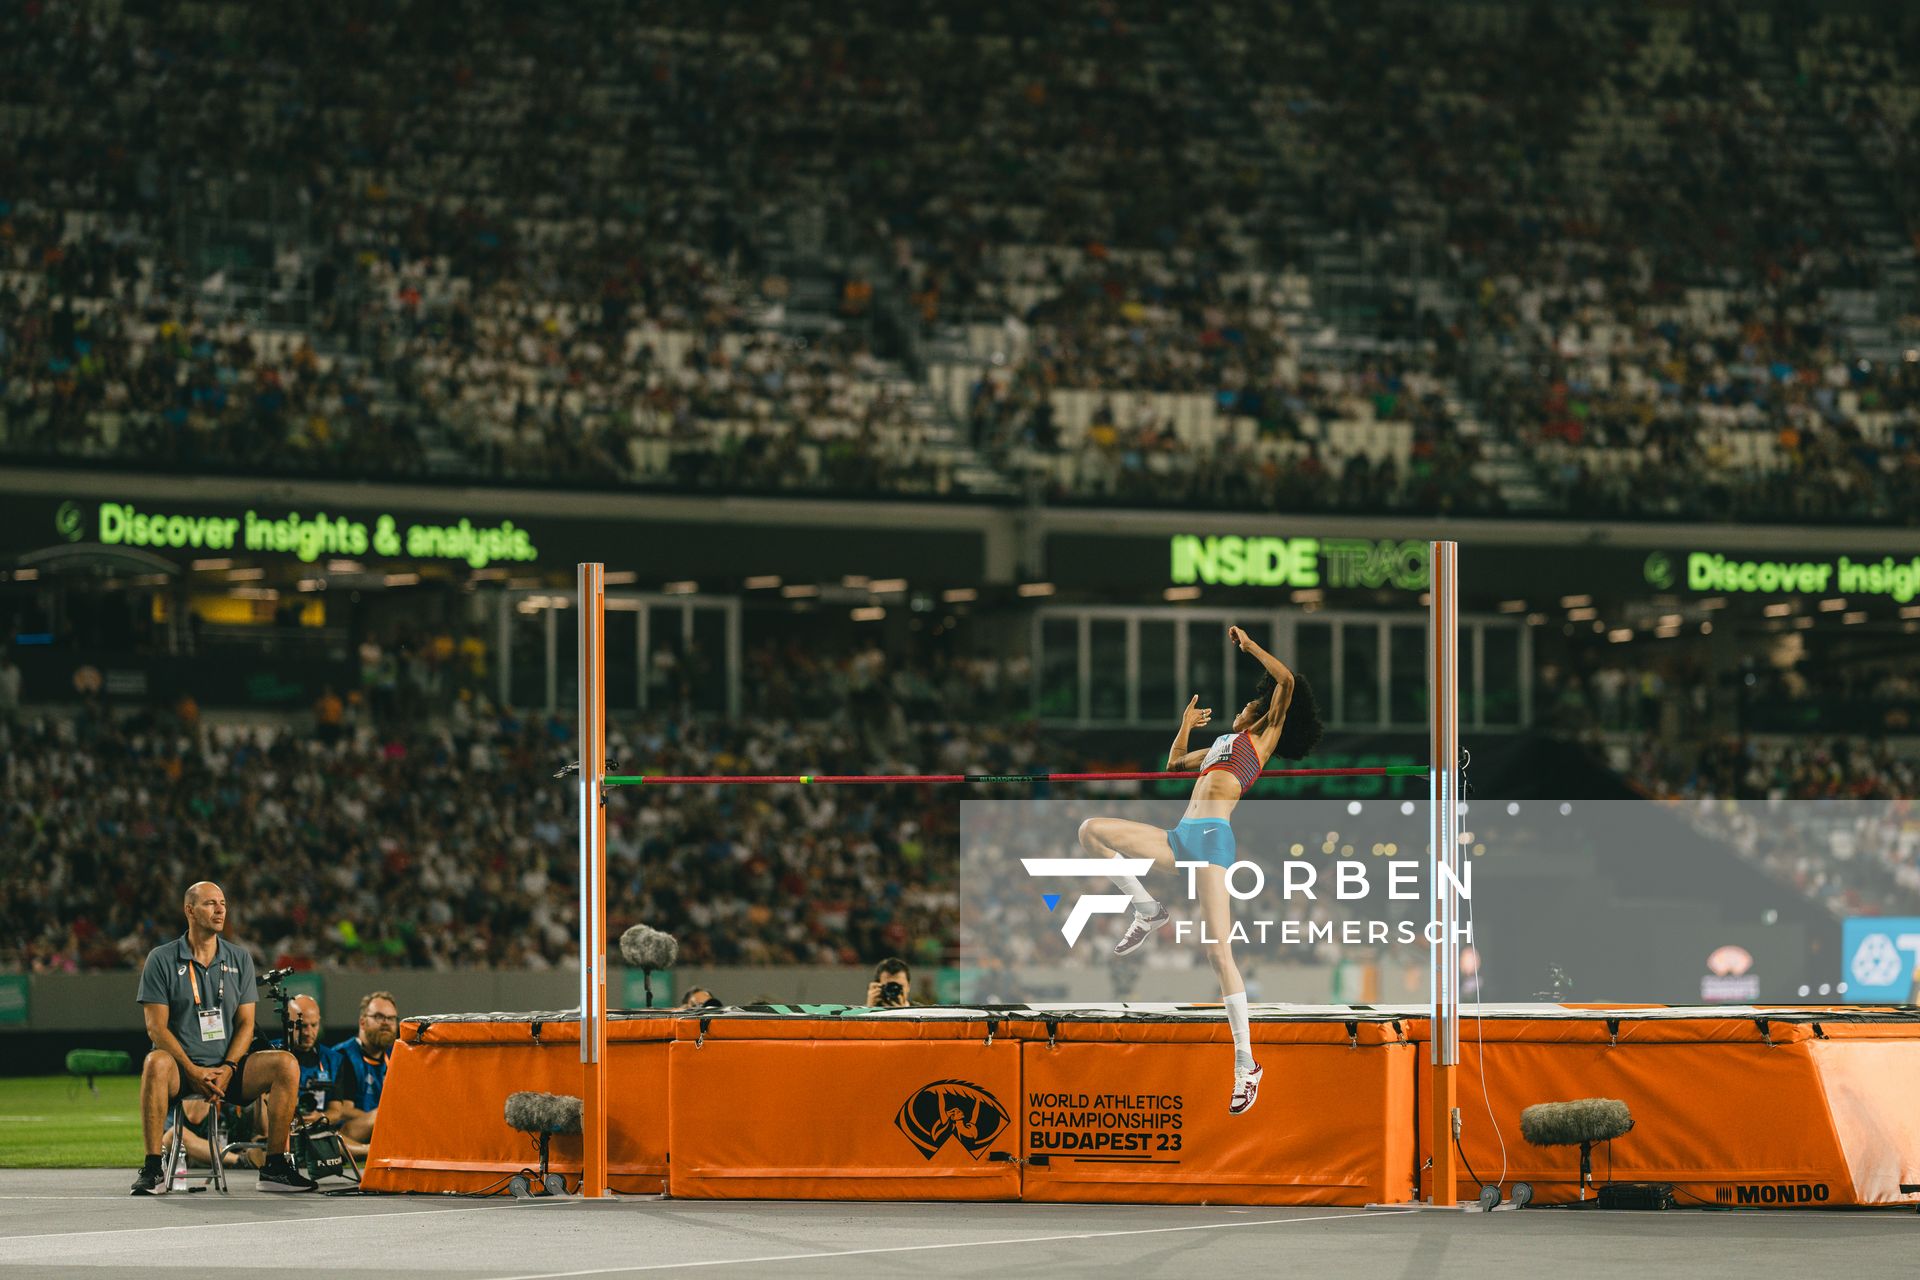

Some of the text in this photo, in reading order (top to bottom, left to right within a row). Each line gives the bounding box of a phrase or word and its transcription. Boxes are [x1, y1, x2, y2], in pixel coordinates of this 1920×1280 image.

[99, 502, 538, 568] Discover insights & analysis.
[1170, 534, 1430, 590] INSIDE TRAC
[1687, 551, 1832, 593] Discover
[1029, 1093, 1183, 1110] WORLD ATHLETICS
[1029, 1111, 1183, 1129] CHAMPIONSHIPS
[1030, 1132, 1182, 1151] BUDAPEST 23
[1736, 1183, 1830, 1204] MONDO
